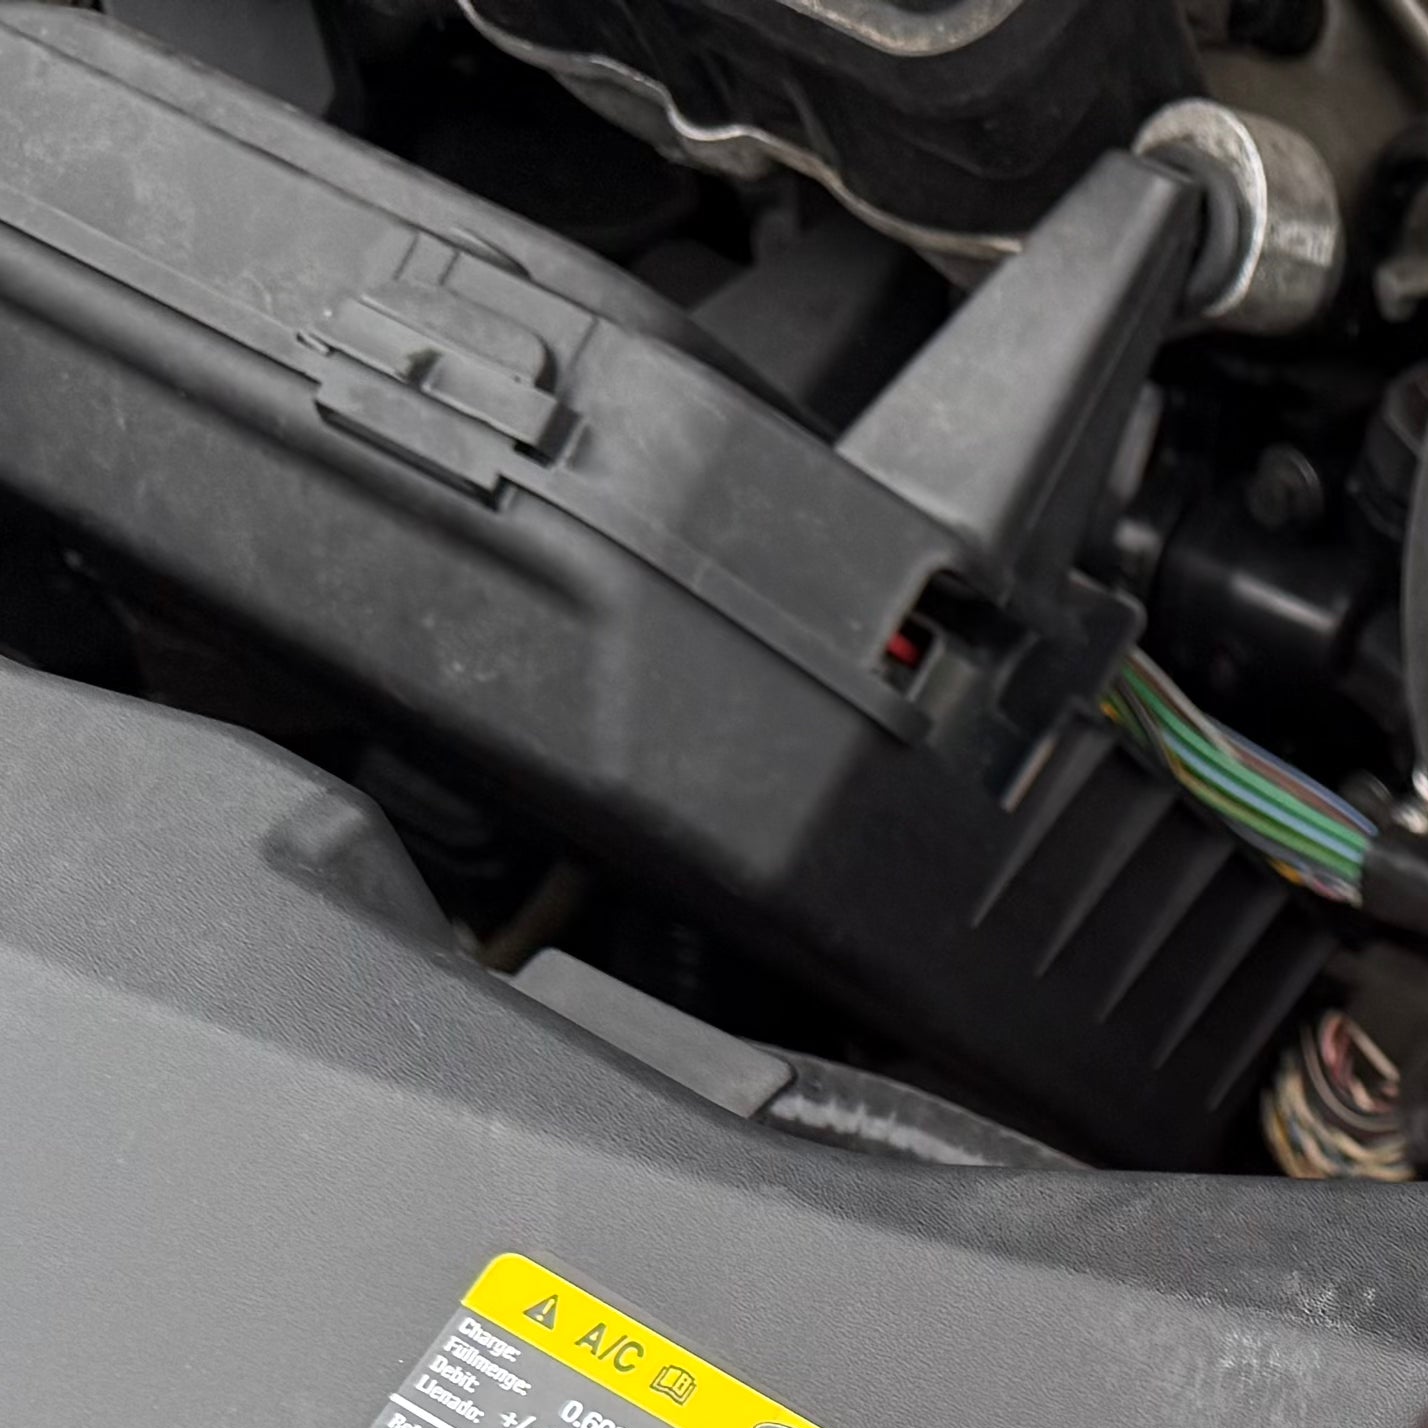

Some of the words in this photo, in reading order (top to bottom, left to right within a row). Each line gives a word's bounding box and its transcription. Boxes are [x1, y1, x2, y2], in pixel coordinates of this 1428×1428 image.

[458, 1317, 521, 1362] Charge:
[575, 1322, 645, 1373] A/C
[414, 1374, 485, 1423] Llenado:
